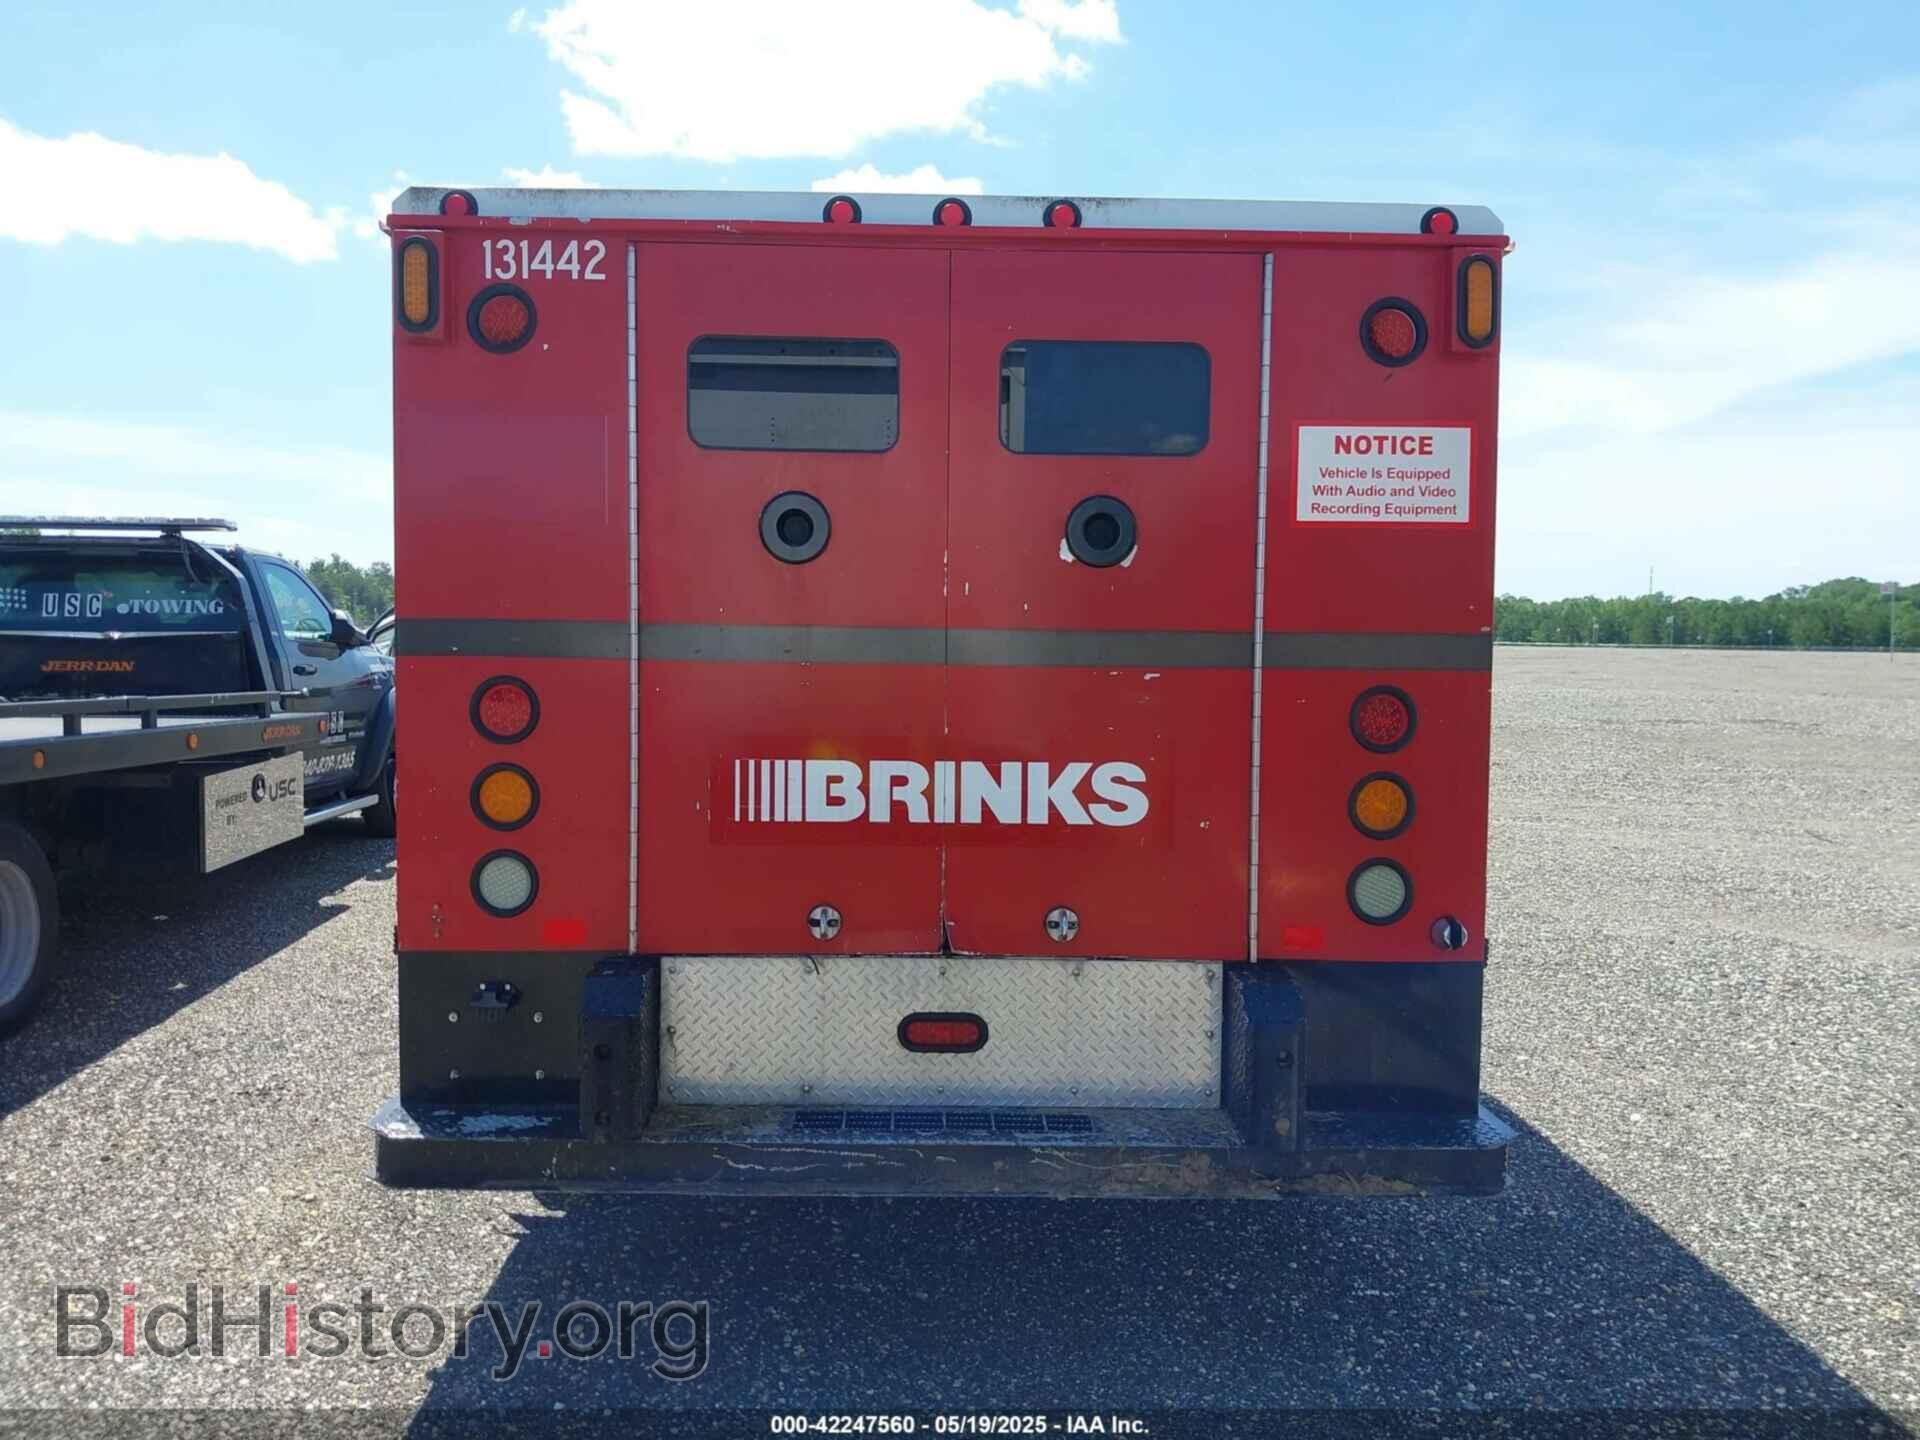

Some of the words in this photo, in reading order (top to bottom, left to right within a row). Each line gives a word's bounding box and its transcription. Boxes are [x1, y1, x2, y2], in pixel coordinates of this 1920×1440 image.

[483, 239, 606, 280] 131442
[1334, 435, 1433, 455] NOTICE
[1319, 467, 1367, 479] Vehicle
[1371, 467, 1383, 479] Is
[1387, 467, 1450, 482] Equipped
[1312, 485, 1342, 497] With
[1346, 485, 1386, 497] Audio
[1390, 485, 1414, 497] and
[1418, 485, 1456, 497] Video
[1311, 502, 1380, 517] Recording
[1385, 503, 1457, 517] Equipment
[215, 792, 247, 807] POWERED
[269, 779, 295, 801] USC
[805, 760, 1149, 826] BRINKS
